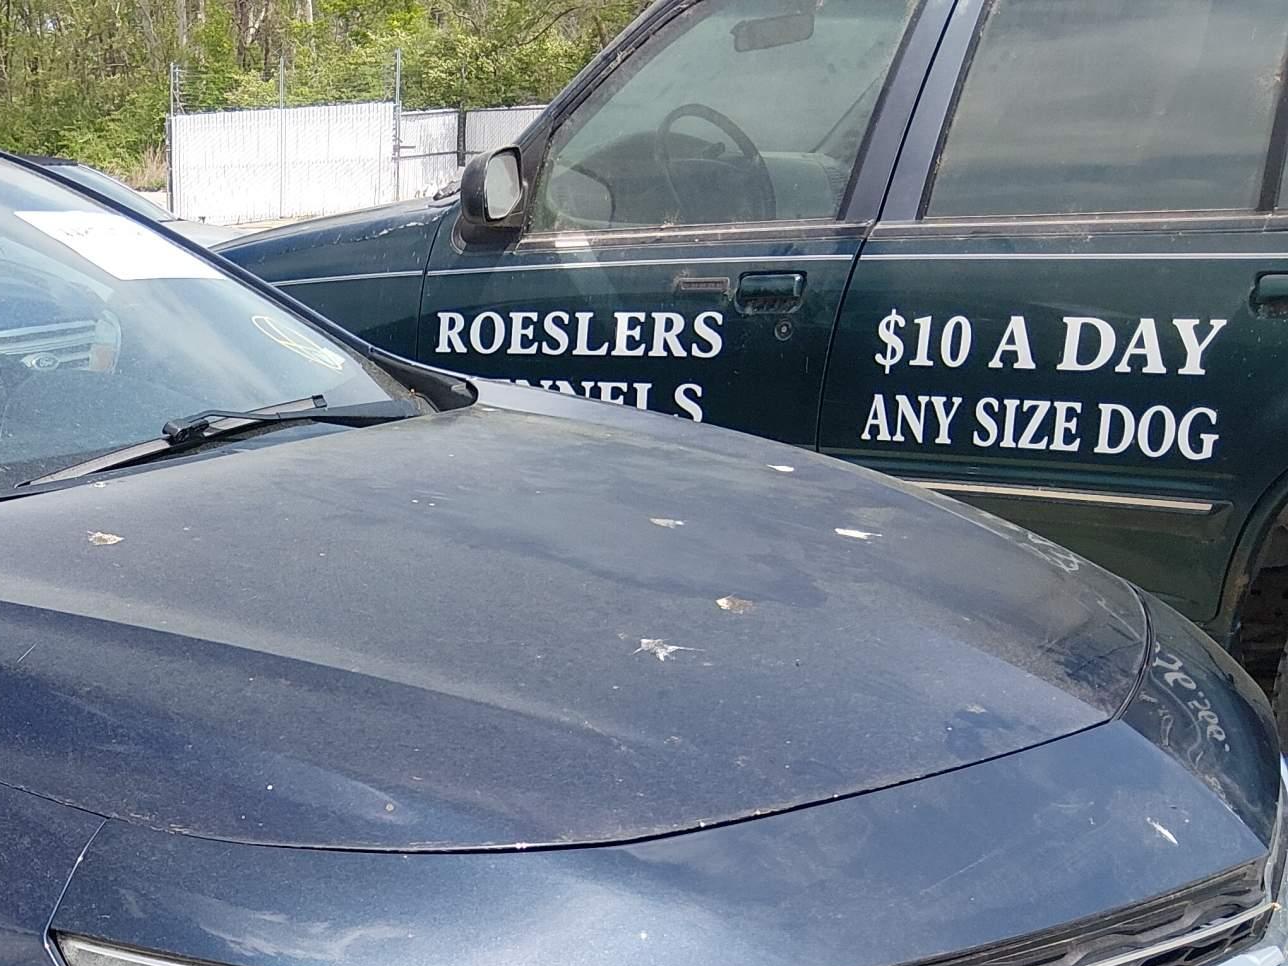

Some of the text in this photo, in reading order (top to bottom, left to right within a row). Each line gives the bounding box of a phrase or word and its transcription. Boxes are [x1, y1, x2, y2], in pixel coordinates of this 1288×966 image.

[435, 311, 724, 359] ROESLERS
[874, 308, 1228, 376] $10 A DAY
[861, 393, 1220, 461] ANY SIZE DOG
